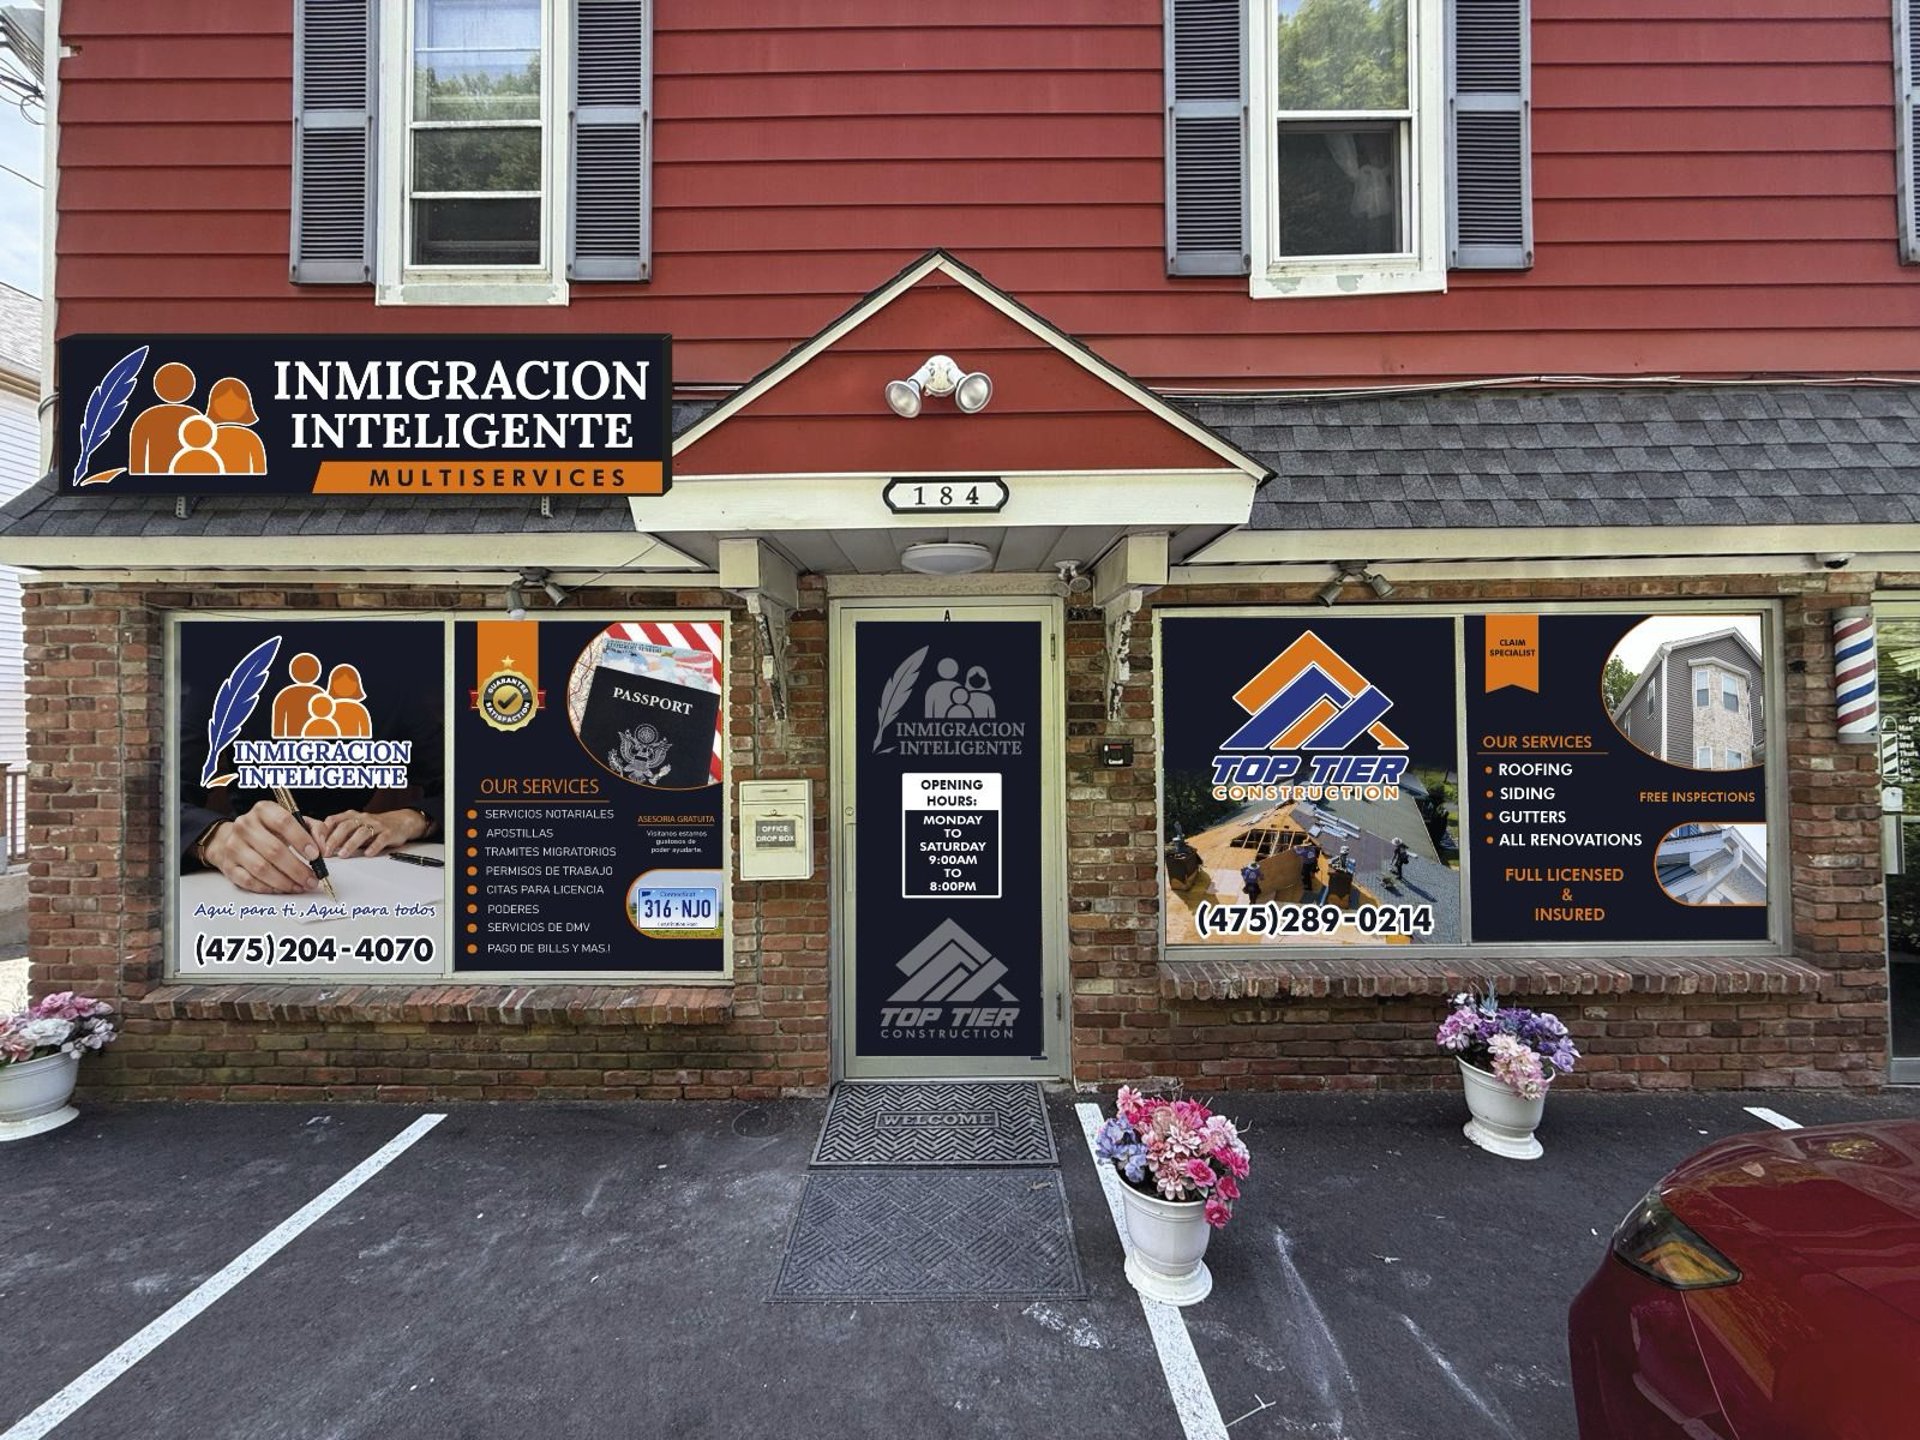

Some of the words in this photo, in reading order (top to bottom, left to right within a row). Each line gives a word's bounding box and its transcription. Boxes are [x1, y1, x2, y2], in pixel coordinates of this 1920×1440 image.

[273, 360, 650, 401] INMIGRACION
[290, 412, 634, 449] INTELIGENTE
[368, 468, 628, 488] MULTISERVICES
[943, 609, 952, 622] A
[1489, 649, 1536, 657] SPECIALIST
[613, 686, 694, 716] PASSPORT
[896, 722, 1025, 738] INMIGRACION
[900, 740, 1022, 756] INTELIGENTE
[1483, 736, 1517, 749] OUR
[1522, 736, 1592, 749] SERVICES
[233, 742, 411, 763] INMIGRACION
[1212, 756, 1301, 784] TOP
[1311, 756, 1408, 784] TIER
[1499, 763, 1573, 776] ROOFING
[239, 767, 408, 787] INTELIGENTE
[480, 778, 519, 795] OUR
[522, 778, 600, 795] SERVICES
[920, 779, 983, 791] OPENING
[1213, 787, 1398, 799] CONSTRUCTION
[1500, 787, 1555, 800] SIDING
[1639, 791, 1669, 803] FREE
[1672, 791, 1755, 803] INSPECTIONS
[927, 795, 977, 807] HOURS:
[485, 808, 543, 820] SERVICIOS
[545, 808, 615, 820] NOTARIALES
[677, 815, 715, 823] GRATUITA
[1499, 811, 1566, 824] GUTTERS
[923, 815, 983, 826] MONDAY
[486, 827, 555, 839] APOSTILLAS
[761, 825, 788, 833] OFFICE
[944, 828, 962, 839] TO
[1499, 834, 1526, 846] ALL
[1531, 834, 1642, 846] RENOVATIONS
[485, 846, 540, 857] TRAMITES
[543, 846, 617, 857] MIGRATORIOS
[920, 842, 987, 852] SATURDAY
[929, 855, 978, 866] 9:00AM
[486, 865, 542, 877] PERMISOS
[545, 865, 561, 877] DE
[562, 865, 614, 877] TRABAJO
[944, 868, 962, 879] TO
[1505, 868, 1542, 882] FULL
[1547, 868, 1624, 882] LICENSED
[486, 884, 518, 896] CITAS
[521, 884, 551, 896] PARA
[553, 884, 605, 896] LICENCIA
[929, 881, 977, 892] 8:00PM
[1562, 888, 1573, 901] &
[194, 903, 235, 917] Aqui
[240, 906, 278, 918] para
[282, 903, 297, 916] ti
[352, 906, 390, 918] para
[395, 903, 436, 916] todos
[487, 904, 541, 915] PODERES
[1535, 908, 1605, 921] INSURED
[1198, 905, 1432, 935] (475)289-0214
[487, 922, 543, 933] SERVICIOS
[547, 922, 562, 933] DE
[565, 922, 591, 933] DMV
[195, 933, 435, 966] (475)204-4070
[487, 943, 518, 954] PAGO
[520, 943, 534, 954] DE
[538, 943, 570, 954] BILLS
[571, 943, 580, 954] Y
[880, 1007, 942, 1027] TOP
[951, 1007, 1020, 1027] TIER
[881, 1029, 1014, 1039] CONSTRUCTION
[883, 1112, 993, 1126] WELCOME
